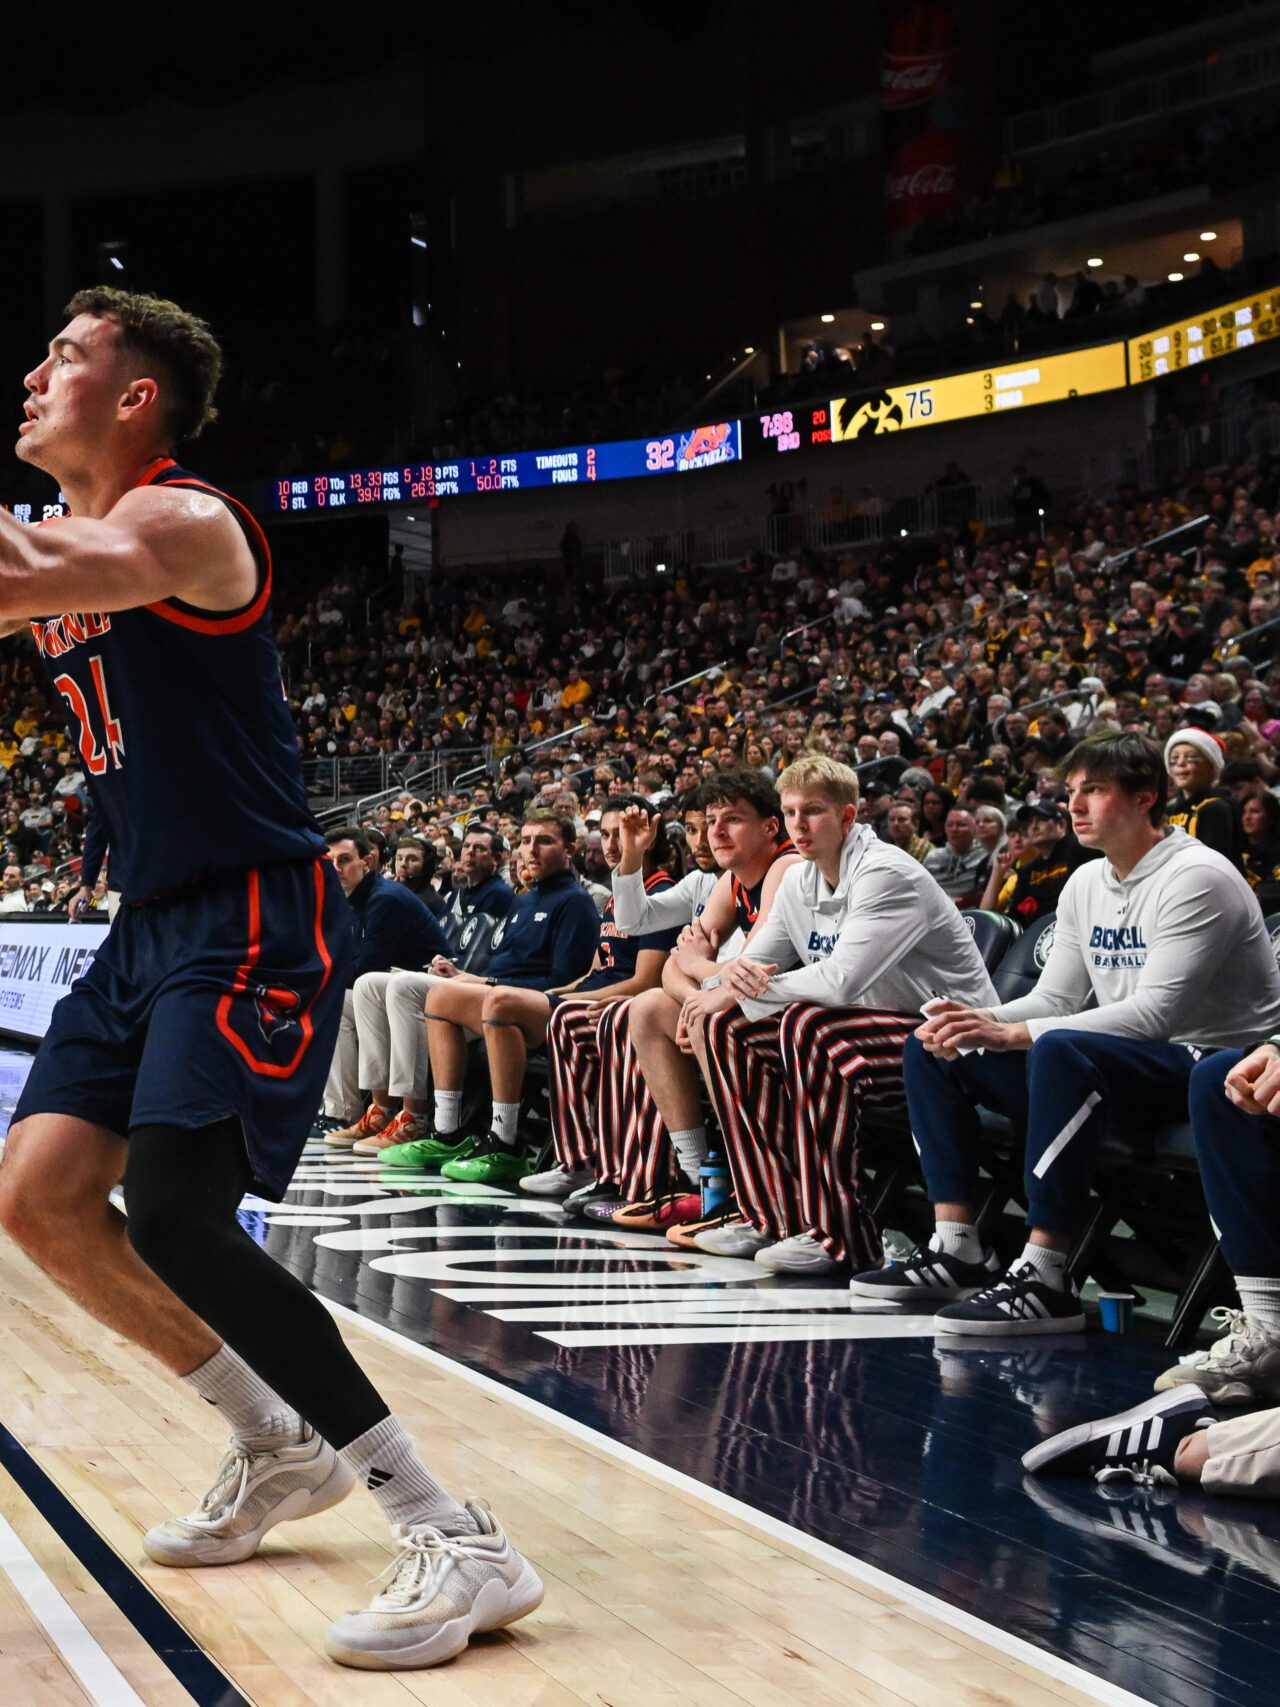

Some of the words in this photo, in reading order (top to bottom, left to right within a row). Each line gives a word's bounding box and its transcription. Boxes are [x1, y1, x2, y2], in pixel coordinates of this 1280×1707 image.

[983, 373, 993, 390] 3
[906, 389, 934, 419] 75
[985, 395, 994, 411] 3
[812, 410, 826, 426] 20
[536, 453, 578, 470] TIMEOUTS
[586, 449, 596, 465] 2
[646, 439, 674, 471] 32
[500, 460, 517, 473] FTS
[383, 472, 399, 485] FGS
[552, 468, 578, 484] FOULS
[586, 466, 597, 482] 4
[278, 481, 290, 495] 10
[292, 481, 308, 494] REB
[314, 476, 328, 492] 20
[280, 496, 288, 510] 5
[292, 496, 307, 510] STL
[318, 491, 325, 507] 0
[329, 493, 346, 506] BLK
[358, 487, 381, 503] 39.4
[383, 488, 401, 501] FG%
[14, 504, 31, 515] REB
